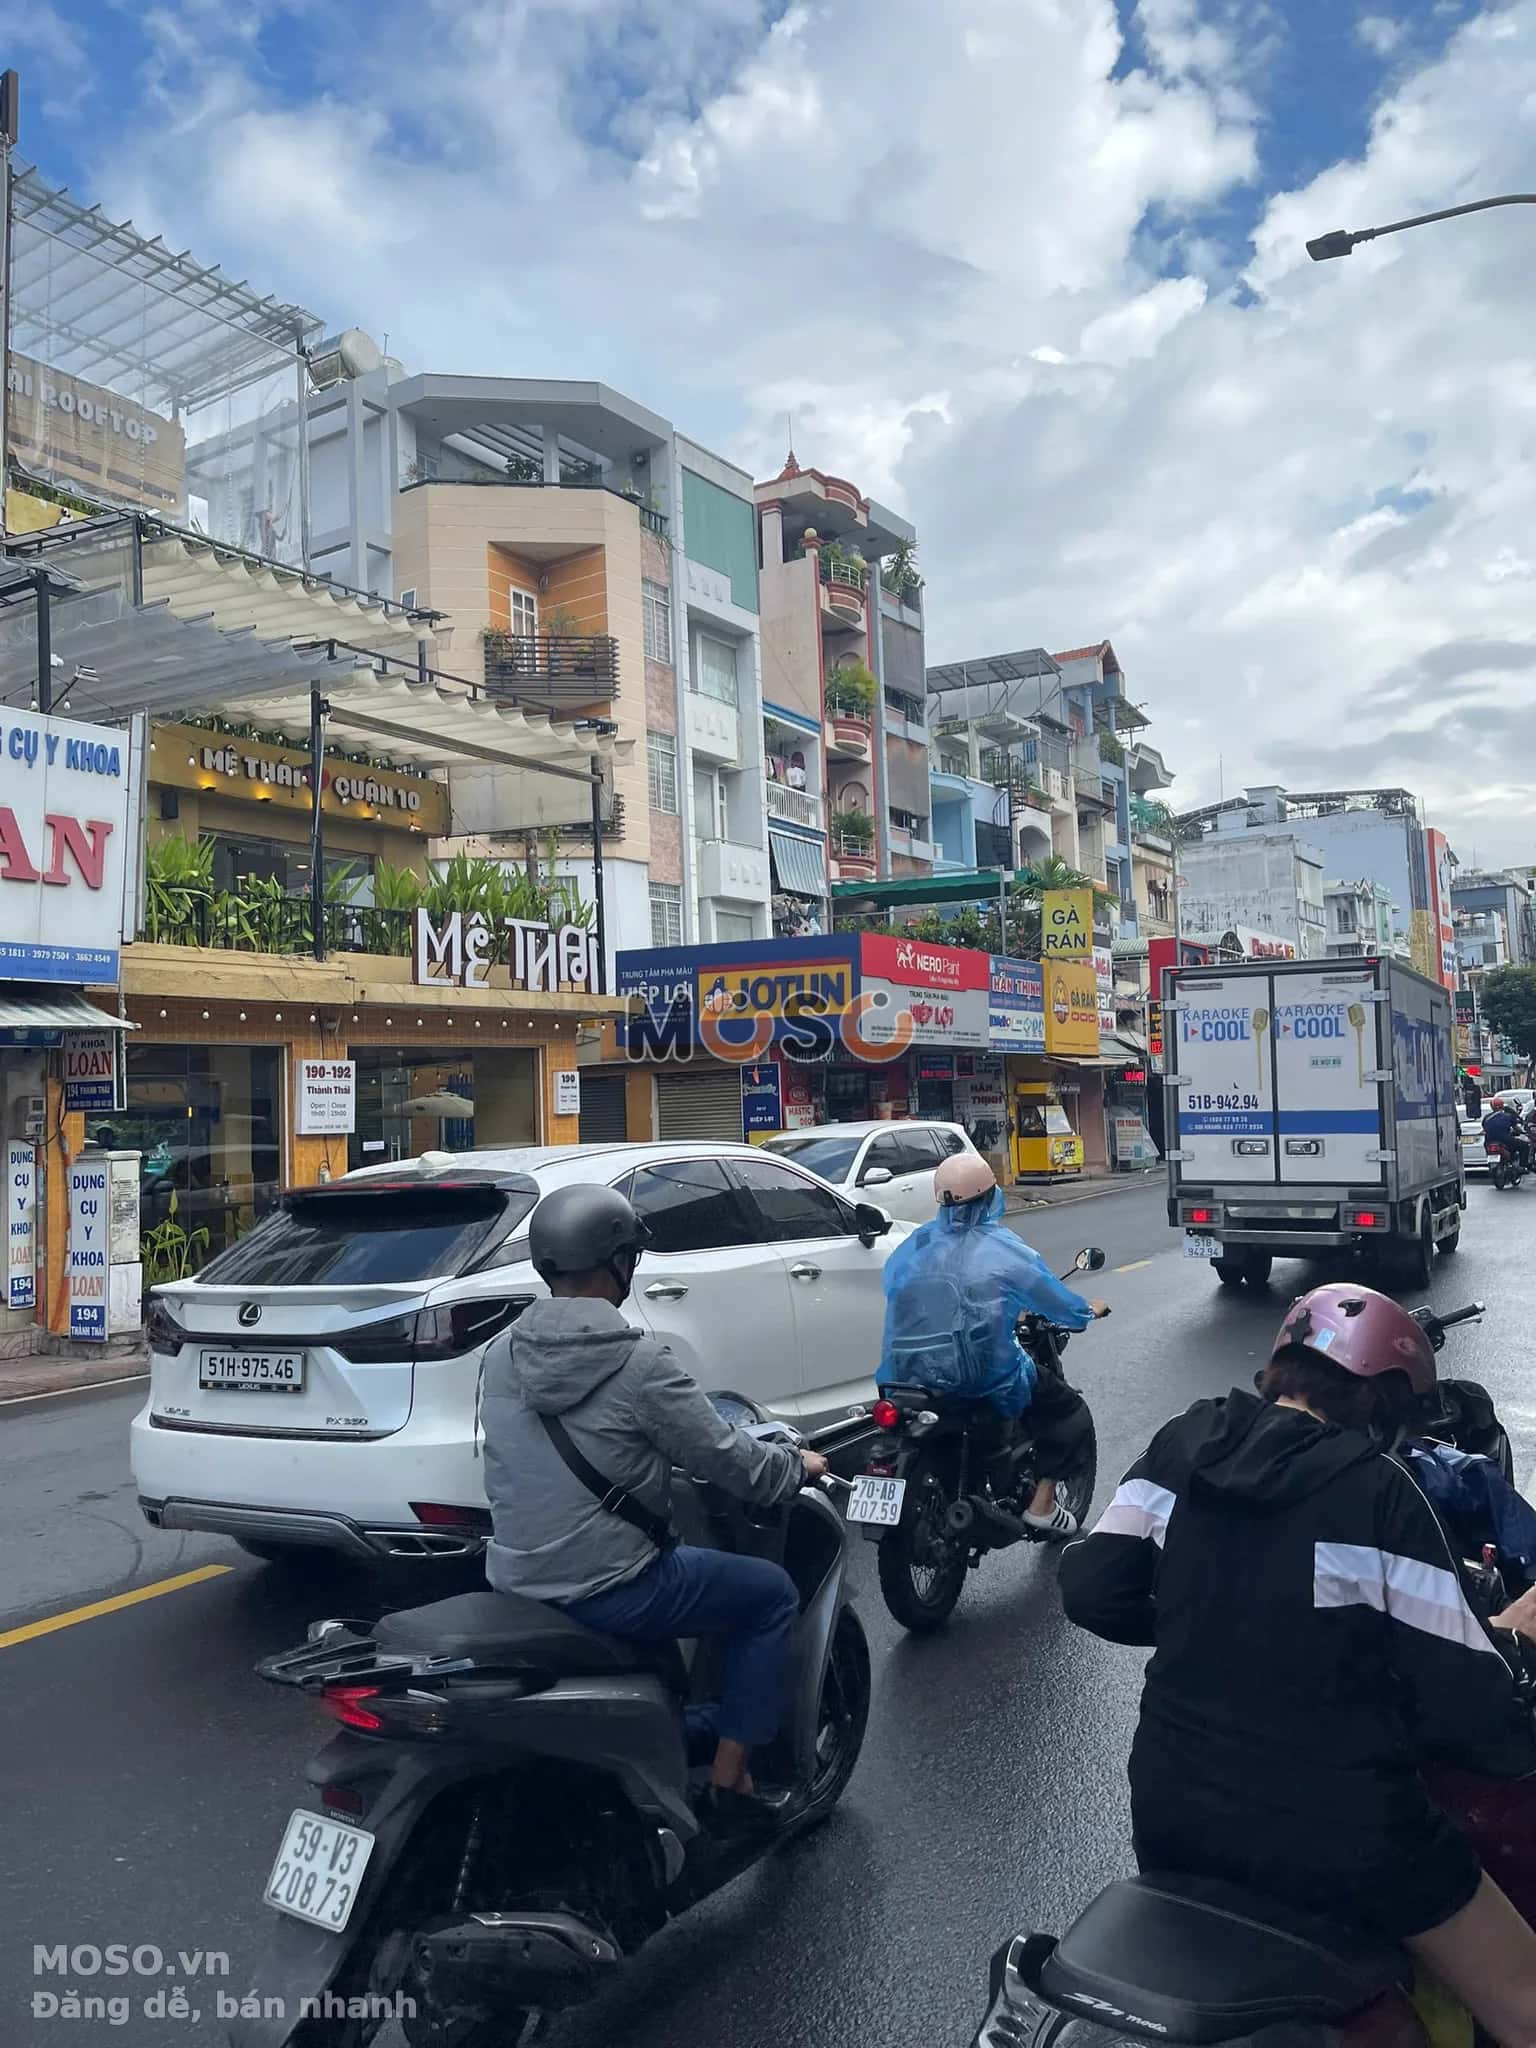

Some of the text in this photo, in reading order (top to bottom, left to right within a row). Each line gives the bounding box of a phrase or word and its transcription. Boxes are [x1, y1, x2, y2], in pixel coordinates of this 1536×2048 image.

[41, 382, 158, 446] ROOFTOP
[9, 727, 121, 778] CỤ Y KHOA
[204, 744, 301, 787] MÊ THÁI
[398, 788, 420, 811] 10
[1052, 904, 1080, 925] GÀ
[1046, 929, 1086, 949] RÁN
[661, 967, 674, 977] PHA
[917, 954, 942, 973] NERO
[736, 972, 846, 1013] JOTUN
[1183, 1008, 1249, 1021] KARAOKE
[1274, 1004, 1345, 1017] KARAOKE
[1202, 1020, 1250, 1042] COOL
[1294, 1016, 1345, 1039] COOL
[81, 1039, 106, 1049] KHOA
[67, 1051, 113, 1076] LOAN
[305, 1065, 351, 1078] 190-192
[561, 1074, 576, 1083] 190
[307, 1084, 351, 1095] Thành Thái
[1188, 1094, 1260, 1110] 51B-942.94
[11, 1151, 34, 1165] DỤNG
[14, 1174, 30, 1189] CỤ
[72, 1175, 106, 1193] DỤNG
[17, 1198, 27, 1211] Y
[80, 1200, 98, 1219] CỤ
[11, 1221, 33, 1236] KHOA
[84, 1226, 93, 1241] Y
[72, 1251, 105, 1267] KHOA
[12, 1278, 32, 1291] 194
[71, 1275, 105, 1297] LOAN
[76, 1308, 99, 1321] 194
[71, 1325, 90, 1338] THÀNH
[208, 1356, 294, 1379] 51H-975.46
[850, 1499, 898, 1522] 707.59
[271, 1861, 351, 1923] 208.73
[1126, 2013, 1168, 2034] mode
